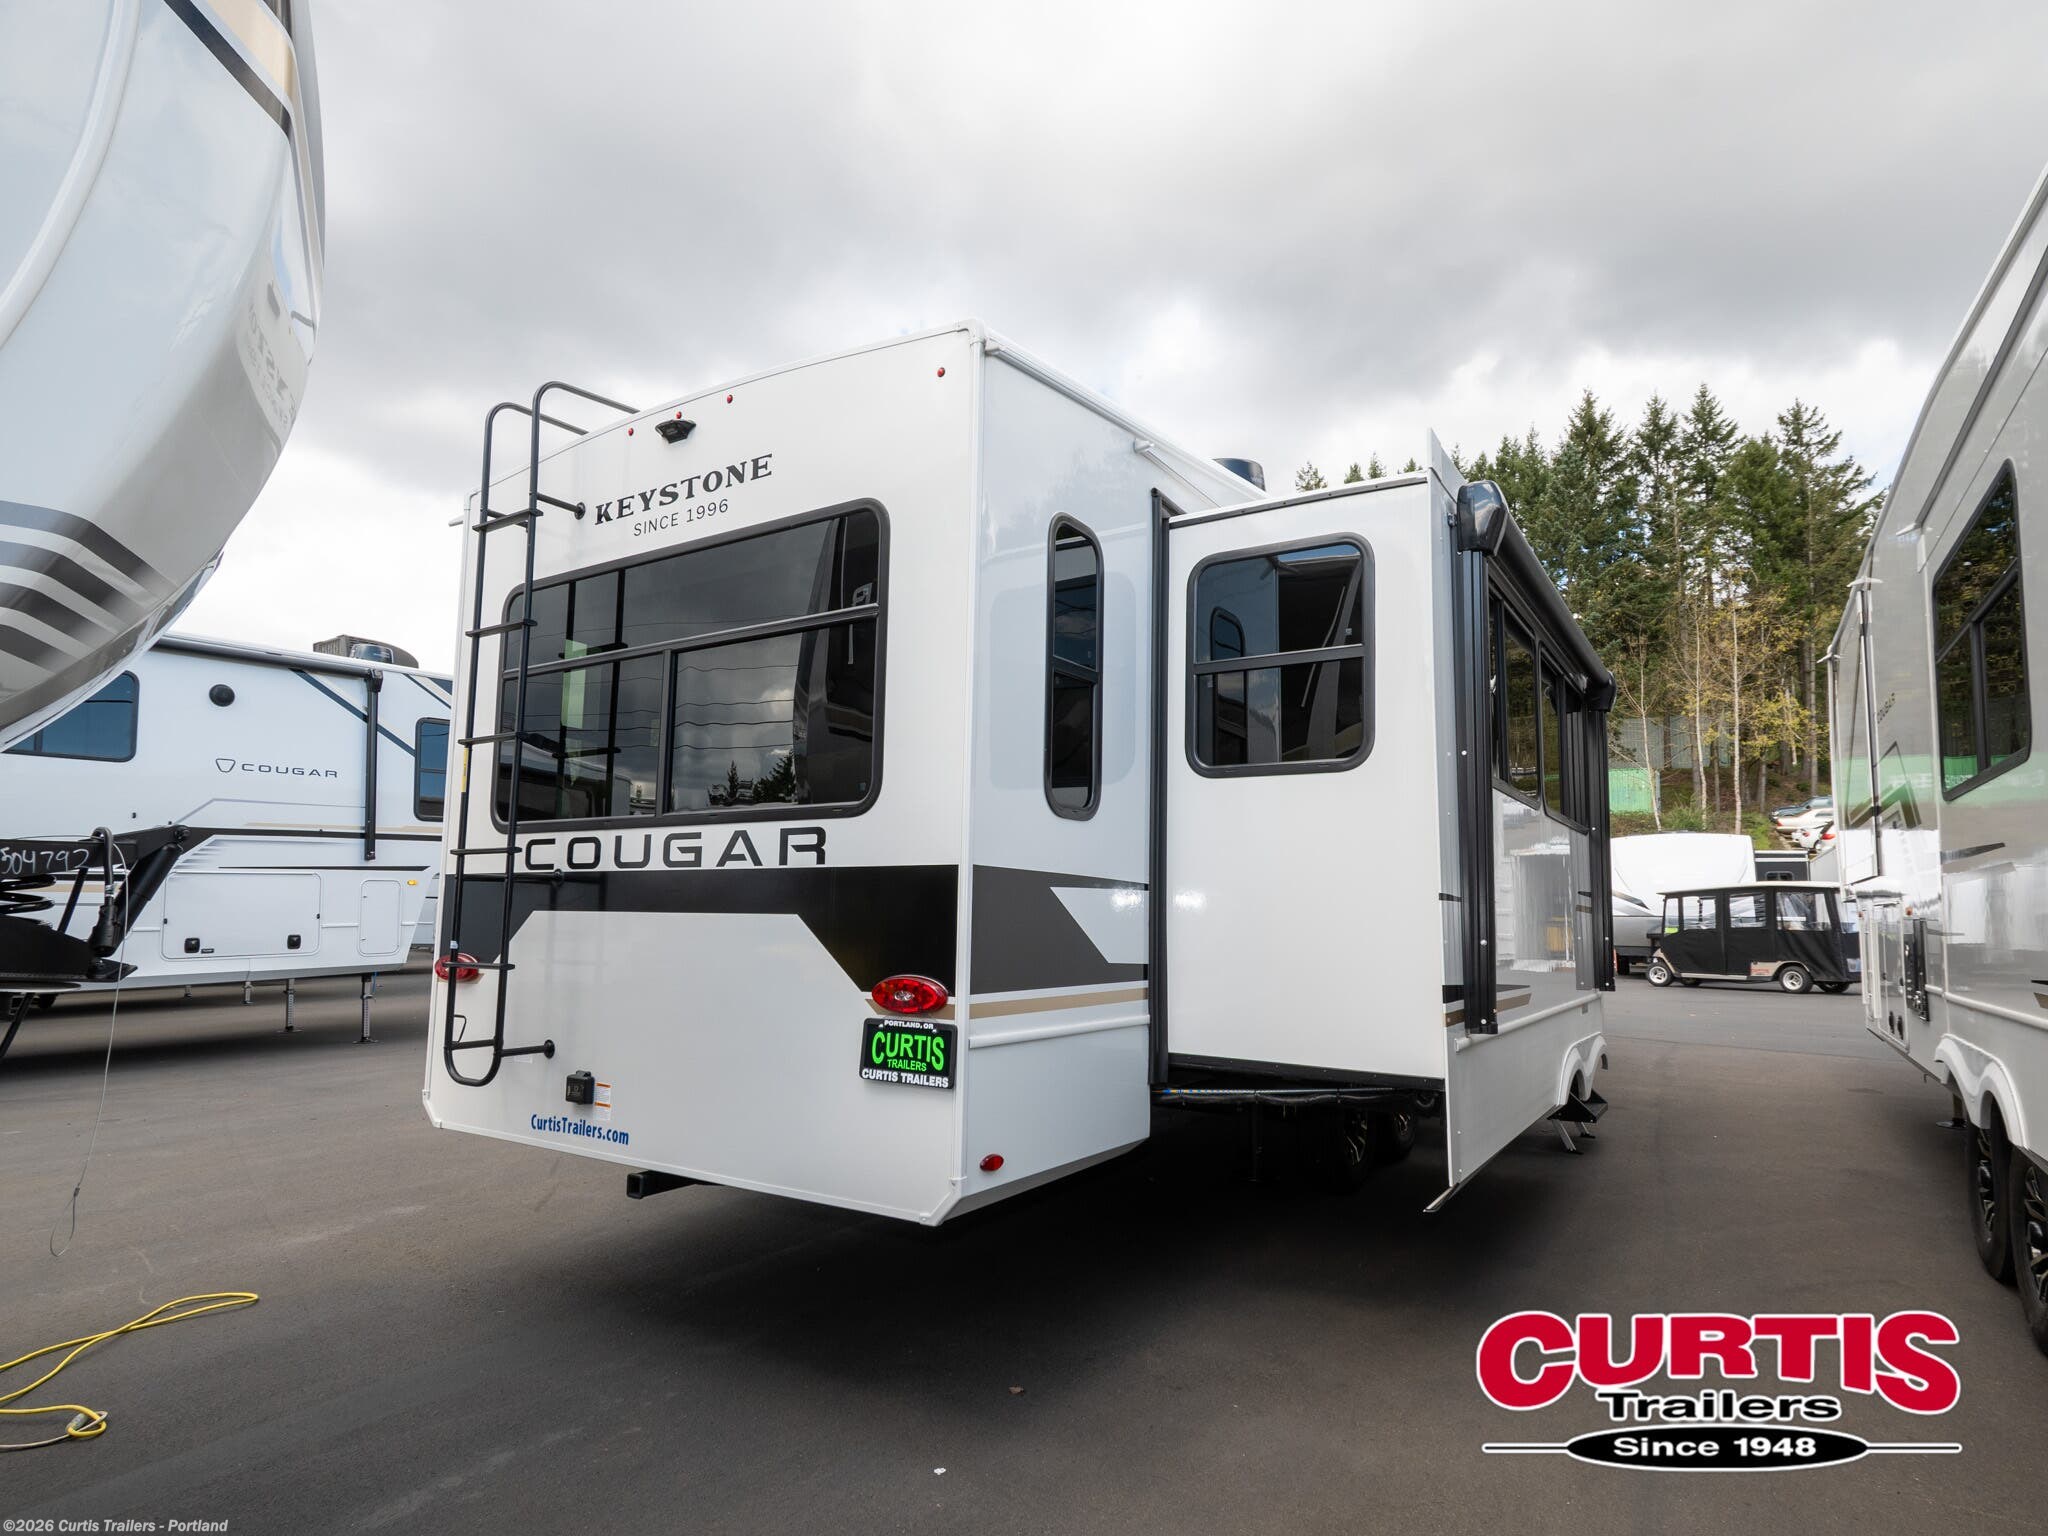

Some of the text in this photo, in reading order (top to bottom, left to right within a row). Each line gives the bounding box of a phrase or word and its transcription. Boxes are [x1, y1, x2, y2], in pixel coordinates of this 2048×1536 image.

[593, 452, 774, 526] KEYSTONE
[633, 498, 729, 537] SINCE 1996
[241, 763, 338, 778] COUGAR
[525, 826, 827, 871] COUGAR
[923, 1022, 934, 1030] OR
[871, 1031, 945, 1071] CURTIS
[887, 1058, 927, 1072] TRAILERS
[862, 1068, 949, 1088] CURTIS TRAILERS
[531, 1114, 630, 1146] CurtisTrailers.com
